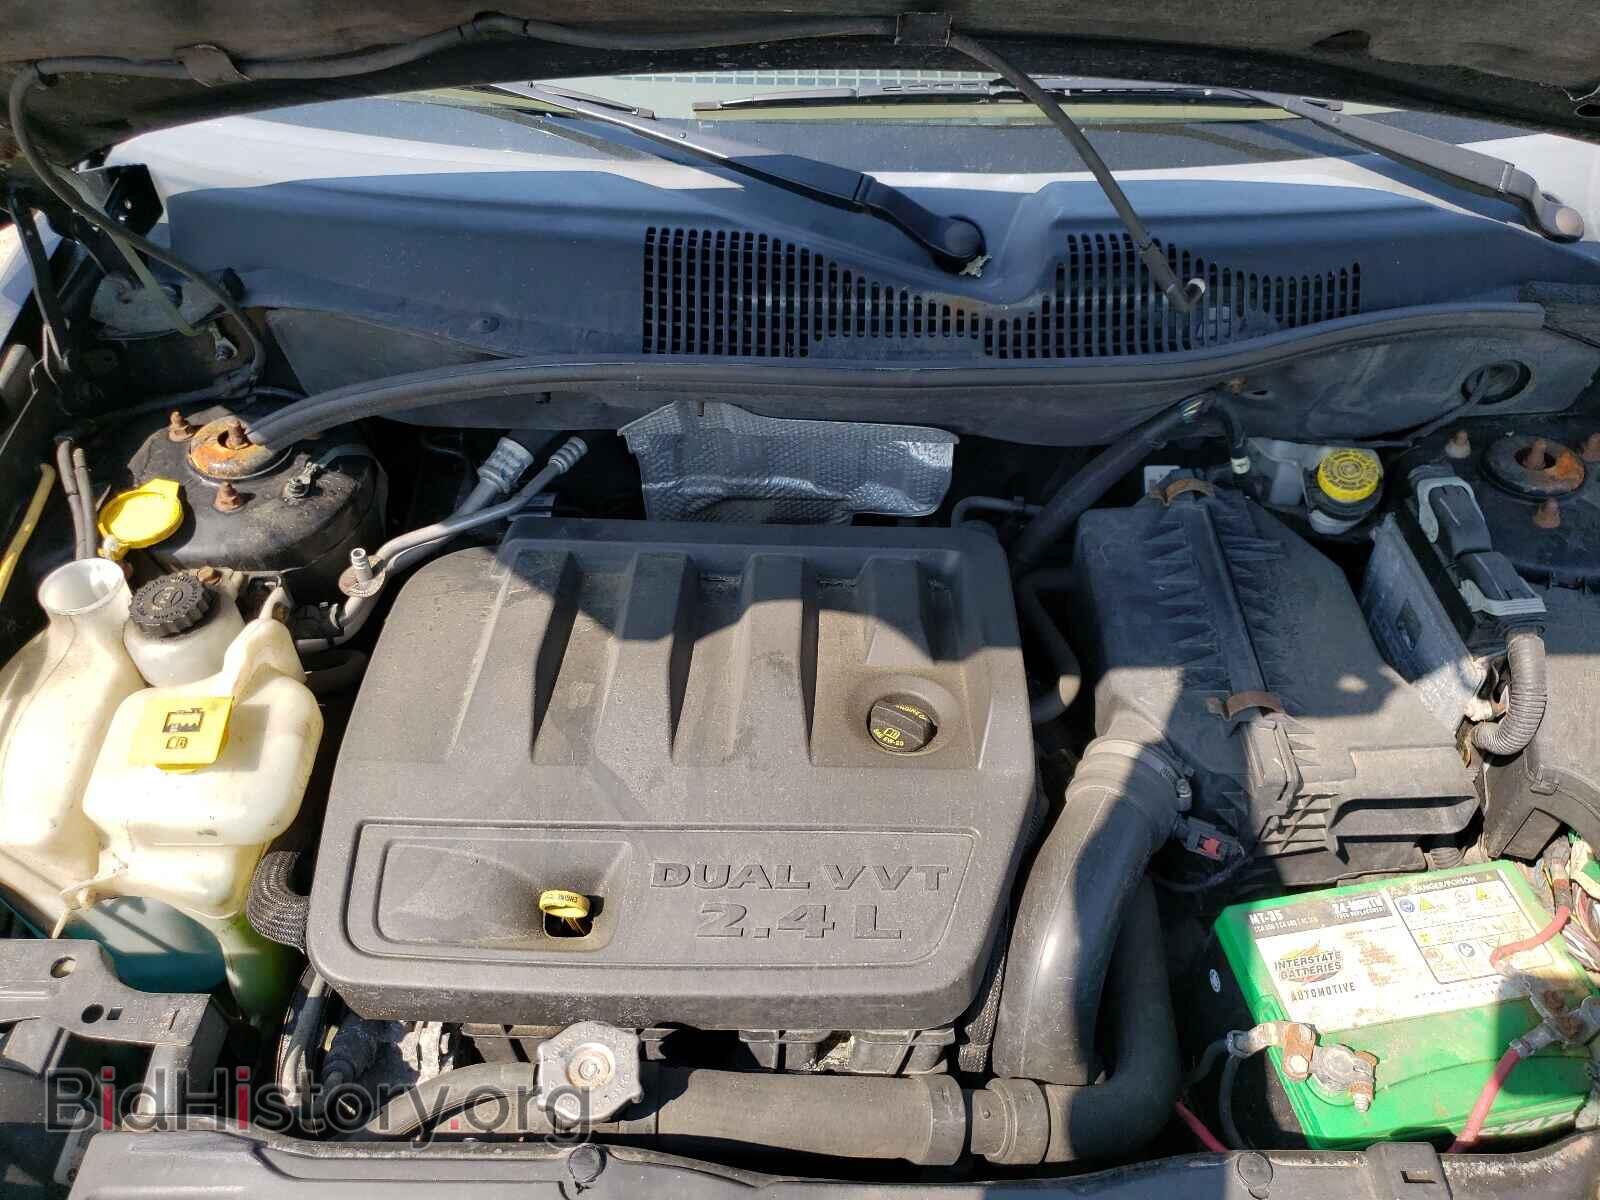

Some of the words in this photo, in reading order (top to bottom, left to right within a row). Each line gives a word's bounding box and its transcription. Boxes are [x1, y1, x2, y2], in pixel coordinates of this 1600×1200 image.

[650, 861, 811, 890] DUAL
[824, 863, 950, 891] VVT
[1274, 951, 1342, 970] INTERSTATE
[1280, 961, 1342, 980] BATTERIES
[1290, 981, 1356, 1002] AUTOMOTIVE
